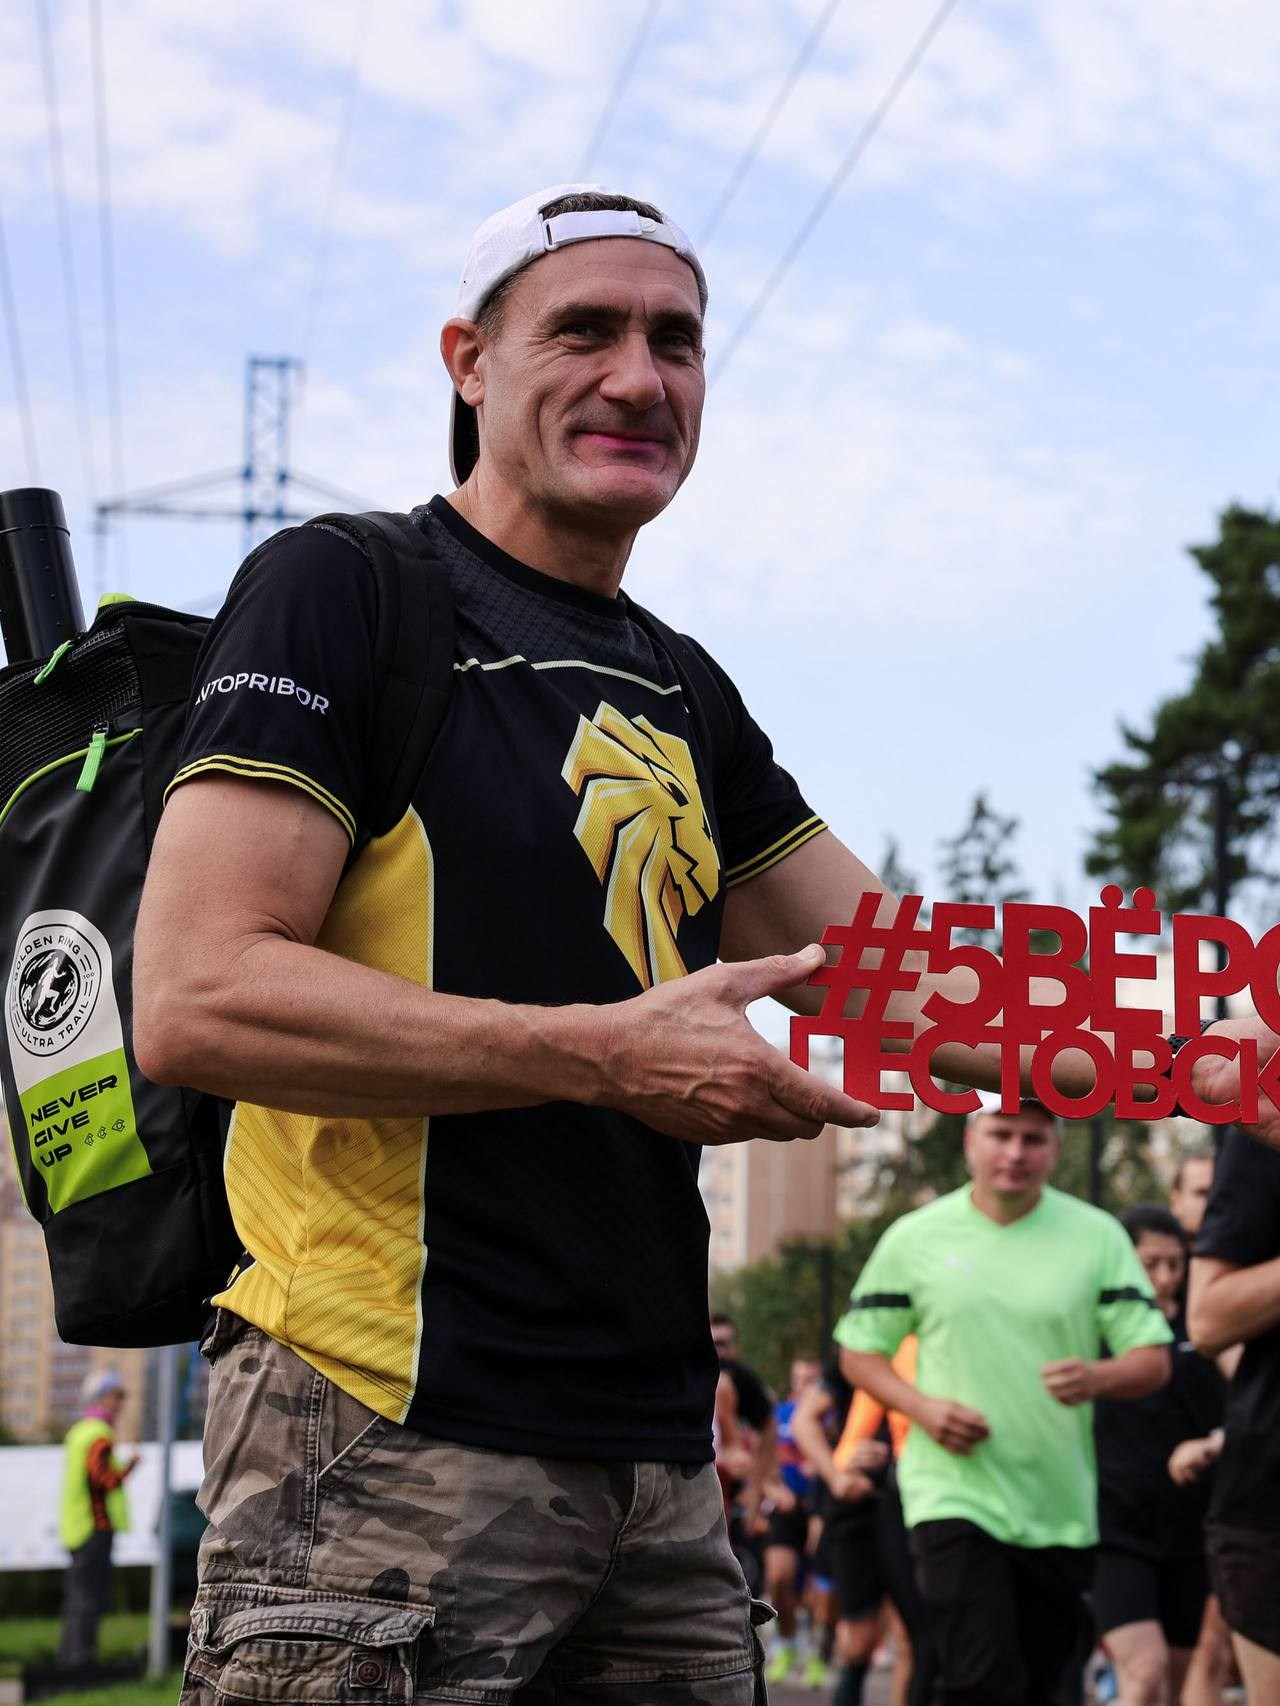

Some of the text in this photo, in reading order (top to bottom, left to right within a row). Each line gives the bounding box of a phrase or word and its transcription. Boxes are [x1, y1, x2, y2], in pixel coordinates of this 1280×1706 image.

[58, 935, 81, 955] RING
[21, 1001, 89, 1048] ULTRA TRAIL
[31, 1075, 118, 1127] NEVER
[34, 1110, 90, 1147] GIVE
[40, 1143, 73, 1168] UP
